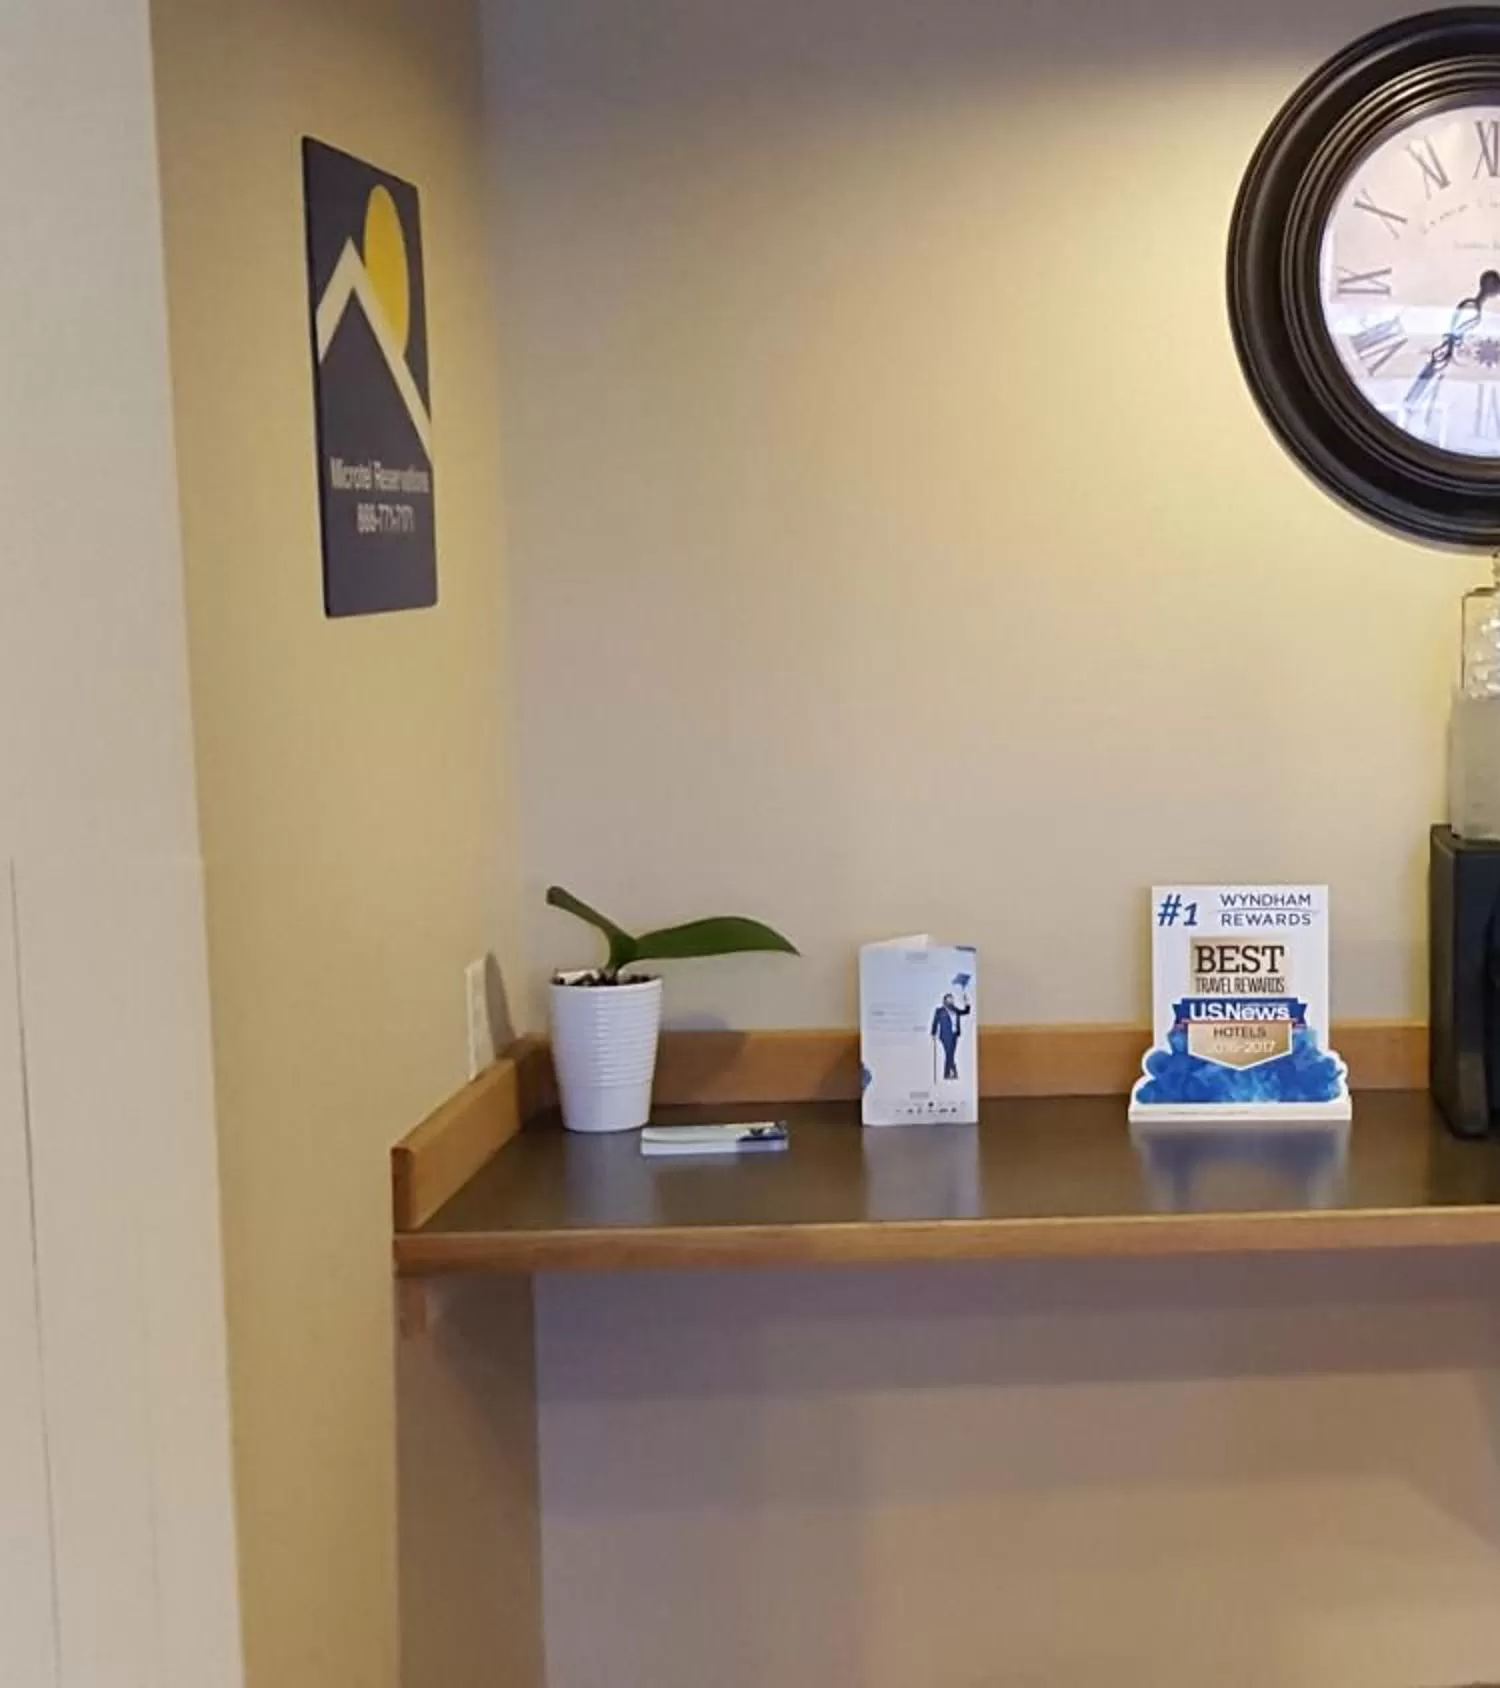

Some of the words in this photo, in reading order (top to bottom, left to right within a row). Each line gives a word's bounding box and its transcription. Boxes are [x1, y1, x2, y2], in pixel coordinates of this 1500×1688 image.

[1353, 189, 1408, 240] X
[330, 456, 371, 491] Microtel
[373, 460, 430, 494] Reservations
[1157, 893, 1199, 927] #1
[1220, 893, 1311, 907] WYNDHAM
[1221, 913, 1311, 926] REWARDS
[1194, 945, 1284, 973] BEST
[1196, 976, 1231, 994] TRAVEL
[1234, 977, 1285, 994] REWARDS
[1213, 1026, 1267, 1038] HOTELS
